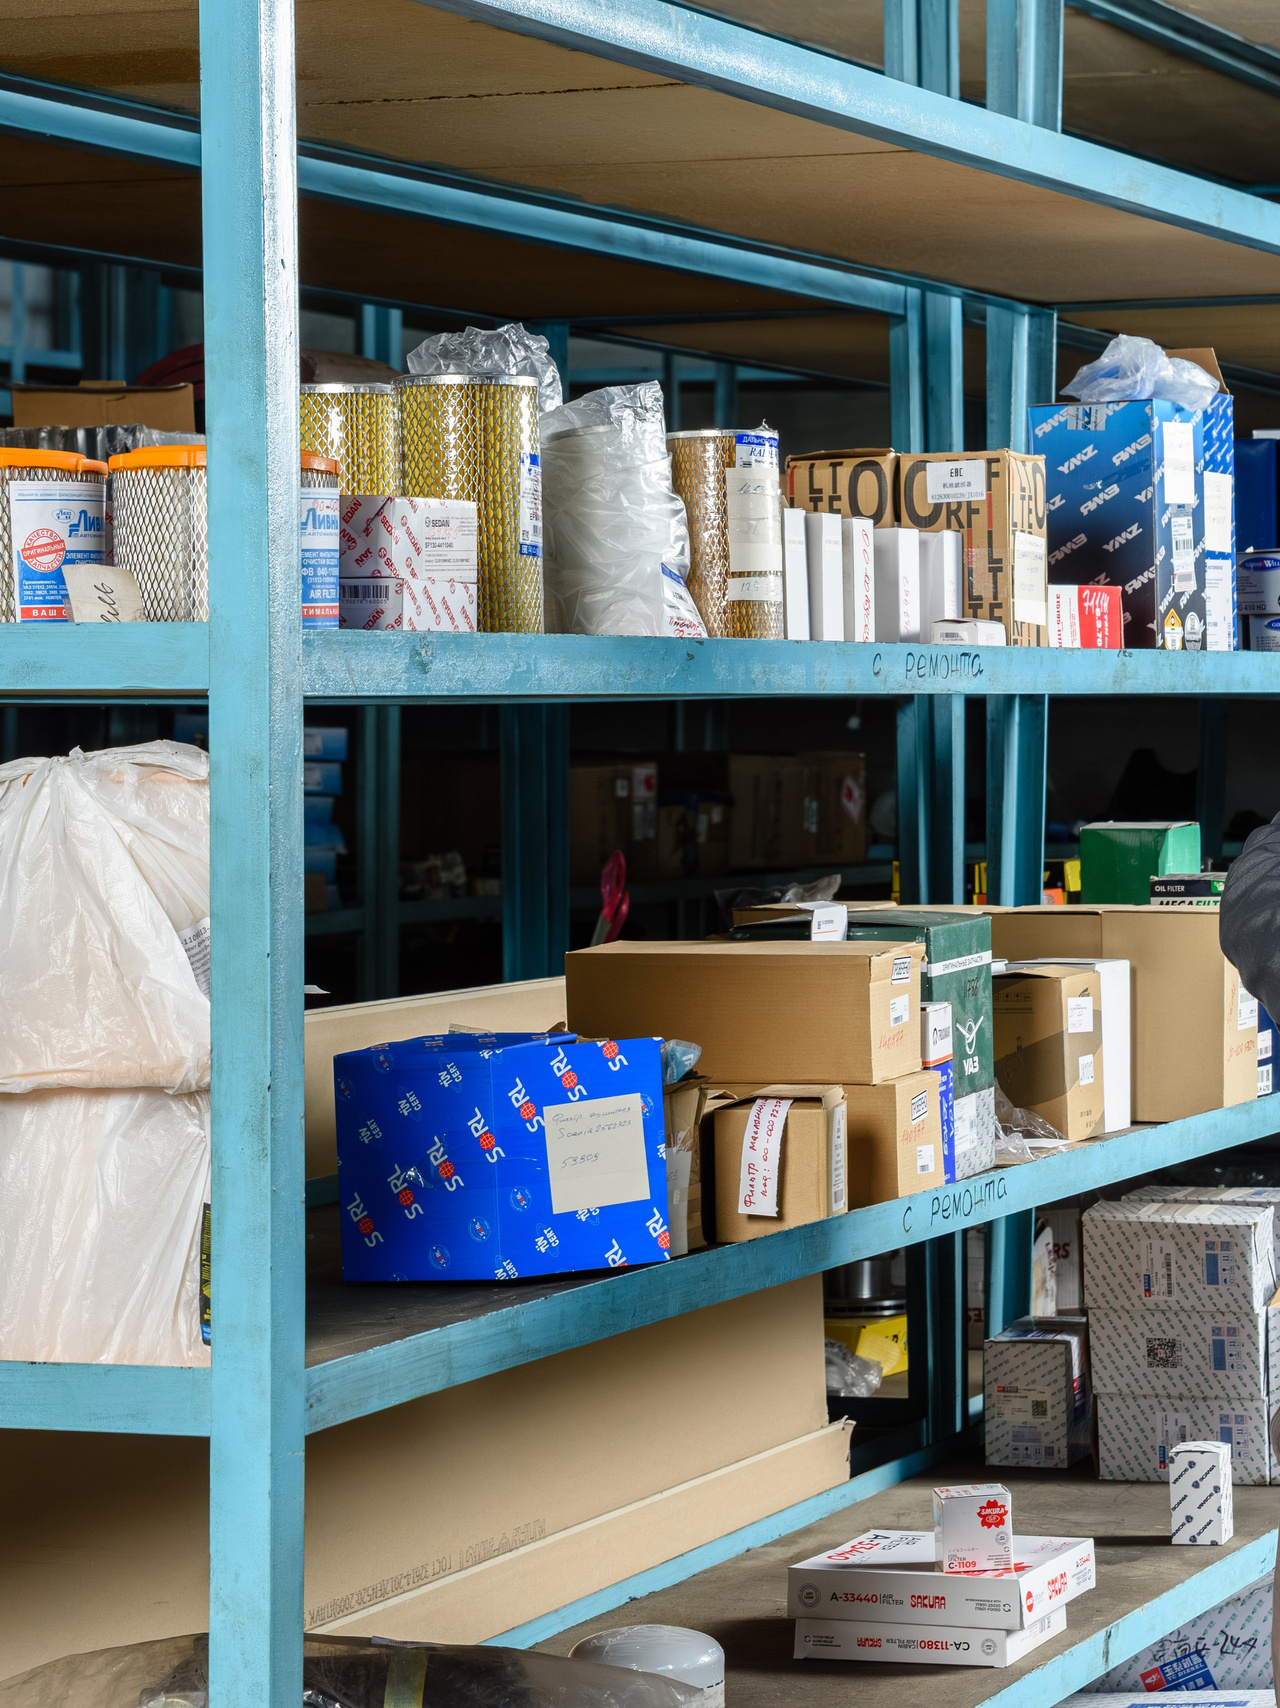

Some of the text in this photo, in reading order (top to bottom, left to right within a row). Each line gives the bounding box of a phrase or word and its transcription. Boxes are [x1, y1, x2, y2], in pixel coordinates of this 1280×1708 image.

[1057, 443, 1098, 474] YMZ
[1112, 433, 1152, 466] ЯМЗ
[1080, 483, 1120, 516] ЯМЗ
[431, 519, 450, 528] SEDAN
[26, 528, 58, 548] КАЧЕСТВО
[405, 526, 422, 557] SEDAN
[1102, 522, 1143, 552] YMZ
[23, 542, 65, 558] ОРИГИНАЛЬНЫХ
[1048, 533, 1087, 565] ЯМЗ
[28, 552, 64, 571] ЗАПЧАСТЕЙ
[423, 585, 437, 615] SEDAN
[441, 596, 456, 625] SEDAN
[447, 1062, 463, 1083] CERT
[963, 1056, 979, 1076] УАЗ
[406, 1090, 422, 1112] CERT
[366, 1118, 383, 1140] CERT
[744, 1162, 759, 1207] Фильтр
[543, 1226, 560, 1249] CERT
[1172, 1467, 1189, 1485] SCANIA
[1199, 1465, 1216, 1482] SCANIA
[1171, 1494, 1188, 1512] SCANIA
[1197, 1492, 1214, 1509] SCANIA
[981, 1507, 1005, 1515] SAKURA
[1196, 1519, 1213, 1537] SCANIA
[827, 1533, 890, 1562] A-33440
[948, 1561, 977, 1569] C-1109
[1047, 1572, 1068, 1601] SAKURA
[830, 1592, 878, 1603] A-33440
[910, 1595, 946, 1609] SAKURA
[857, 1637, 882, 1648] SAKURA
[919, 1640, 970, 1650] CA-11380
[1178, 1663, 1204, 1677] DIESEL
